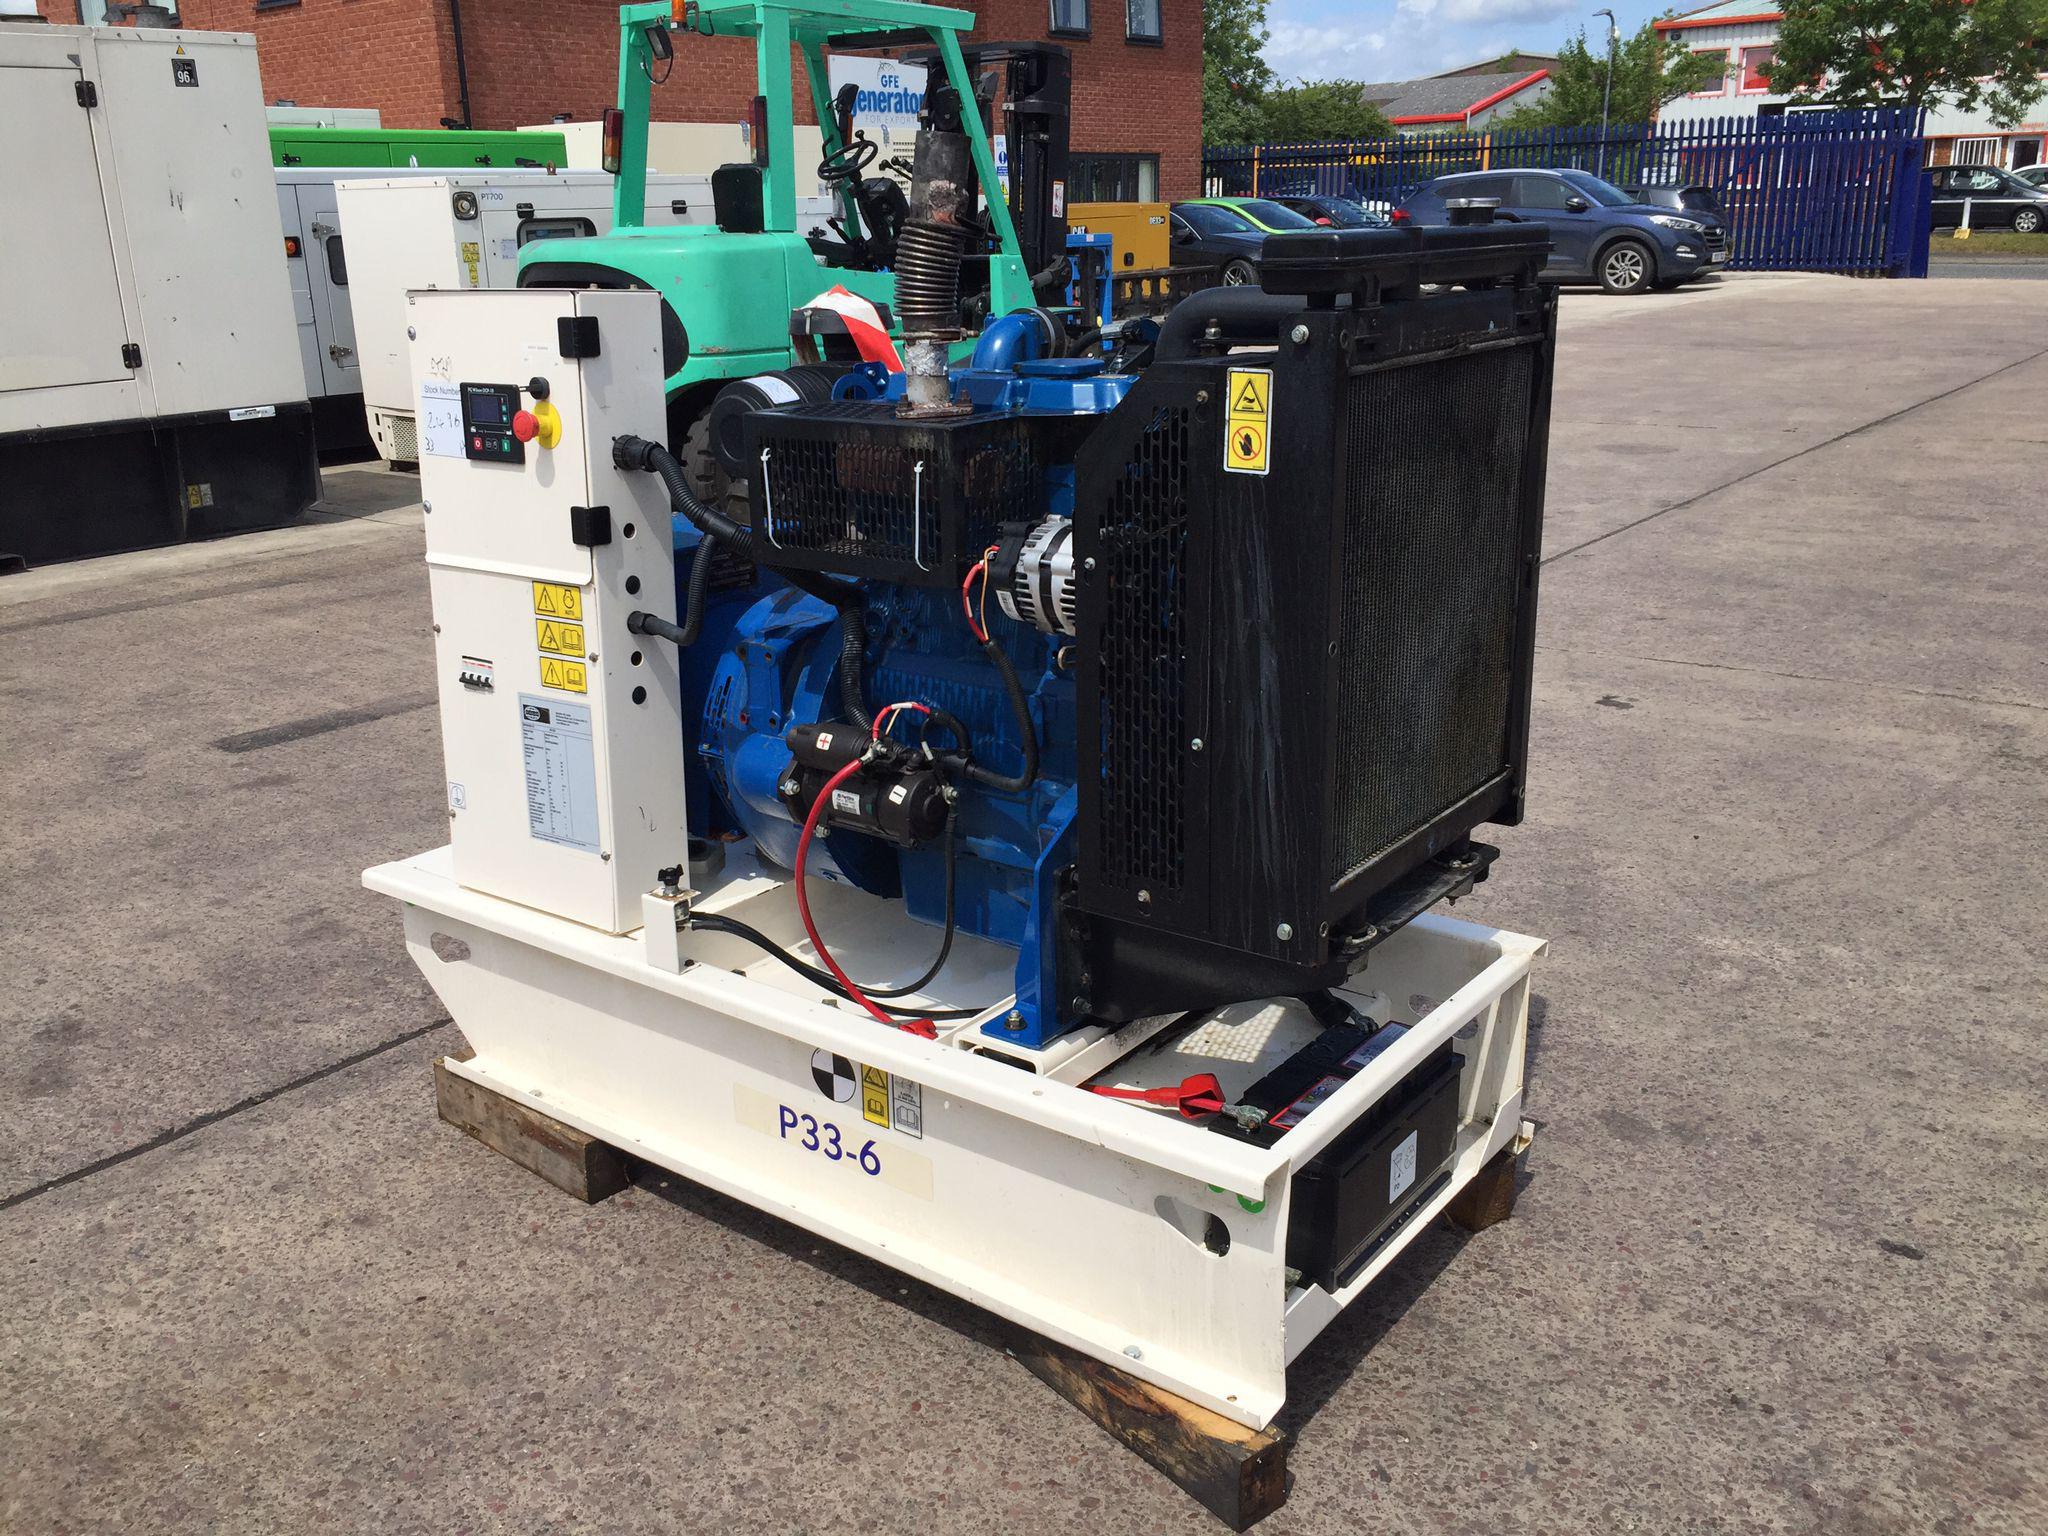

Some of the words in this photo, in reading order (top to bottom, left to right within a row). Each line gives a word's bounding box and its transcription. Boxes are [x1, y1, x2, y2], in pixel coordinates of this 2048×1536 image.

[177, 70, 190, 83] 96
[881, 75, 899, 88] GFE
[865, 114, 881, 122] FOR
[424, 385, 438, 393] Stock
[779, 1104, 881, 1176] P33-6
